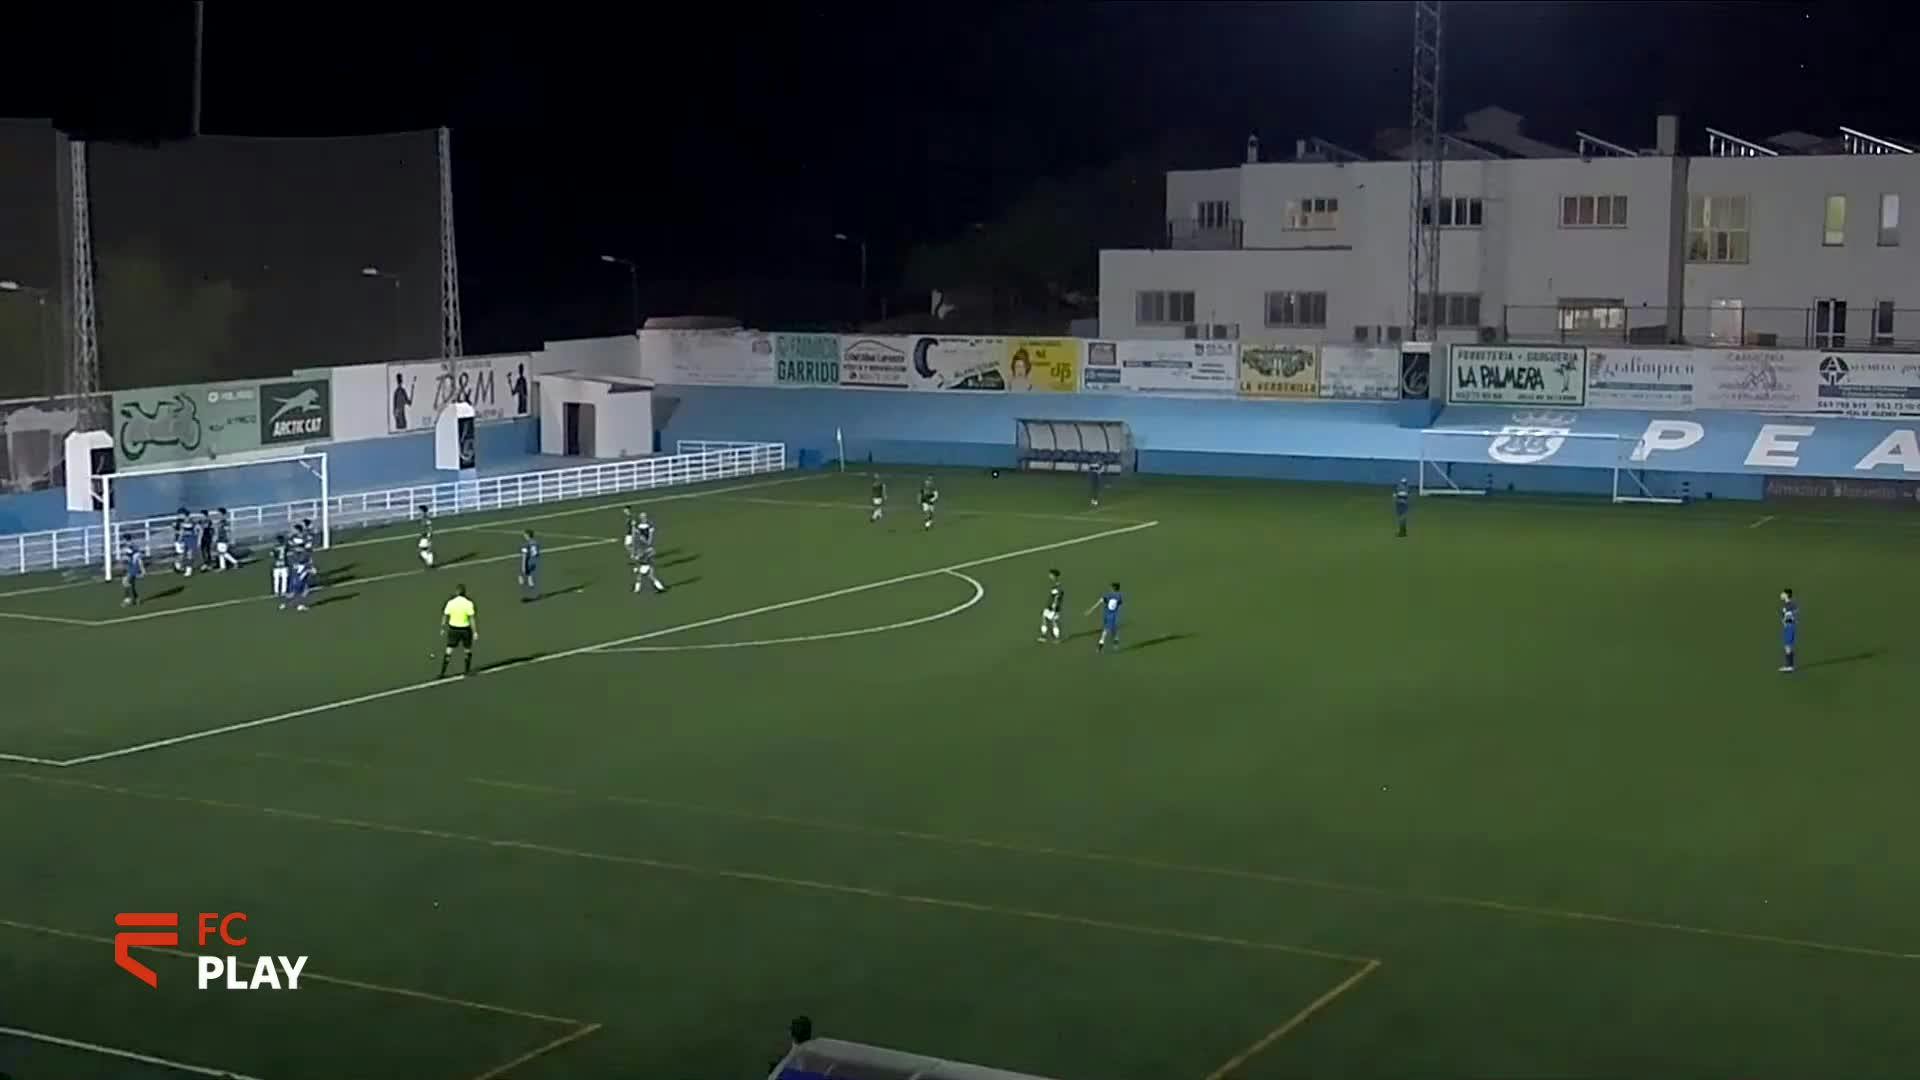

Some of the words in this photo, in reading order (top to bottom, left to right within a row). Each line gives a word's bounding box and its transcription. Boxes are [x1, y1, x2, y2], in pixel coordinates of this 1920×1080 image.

[777, 360, 839, 383] GARRIDO
[1458, 365, 1477, 388] LA
[1480, 365, 1545, 391] PALMERA
[272, 418, 304, 437] ARCTIC
[304, 417, 323, 433] CAT
